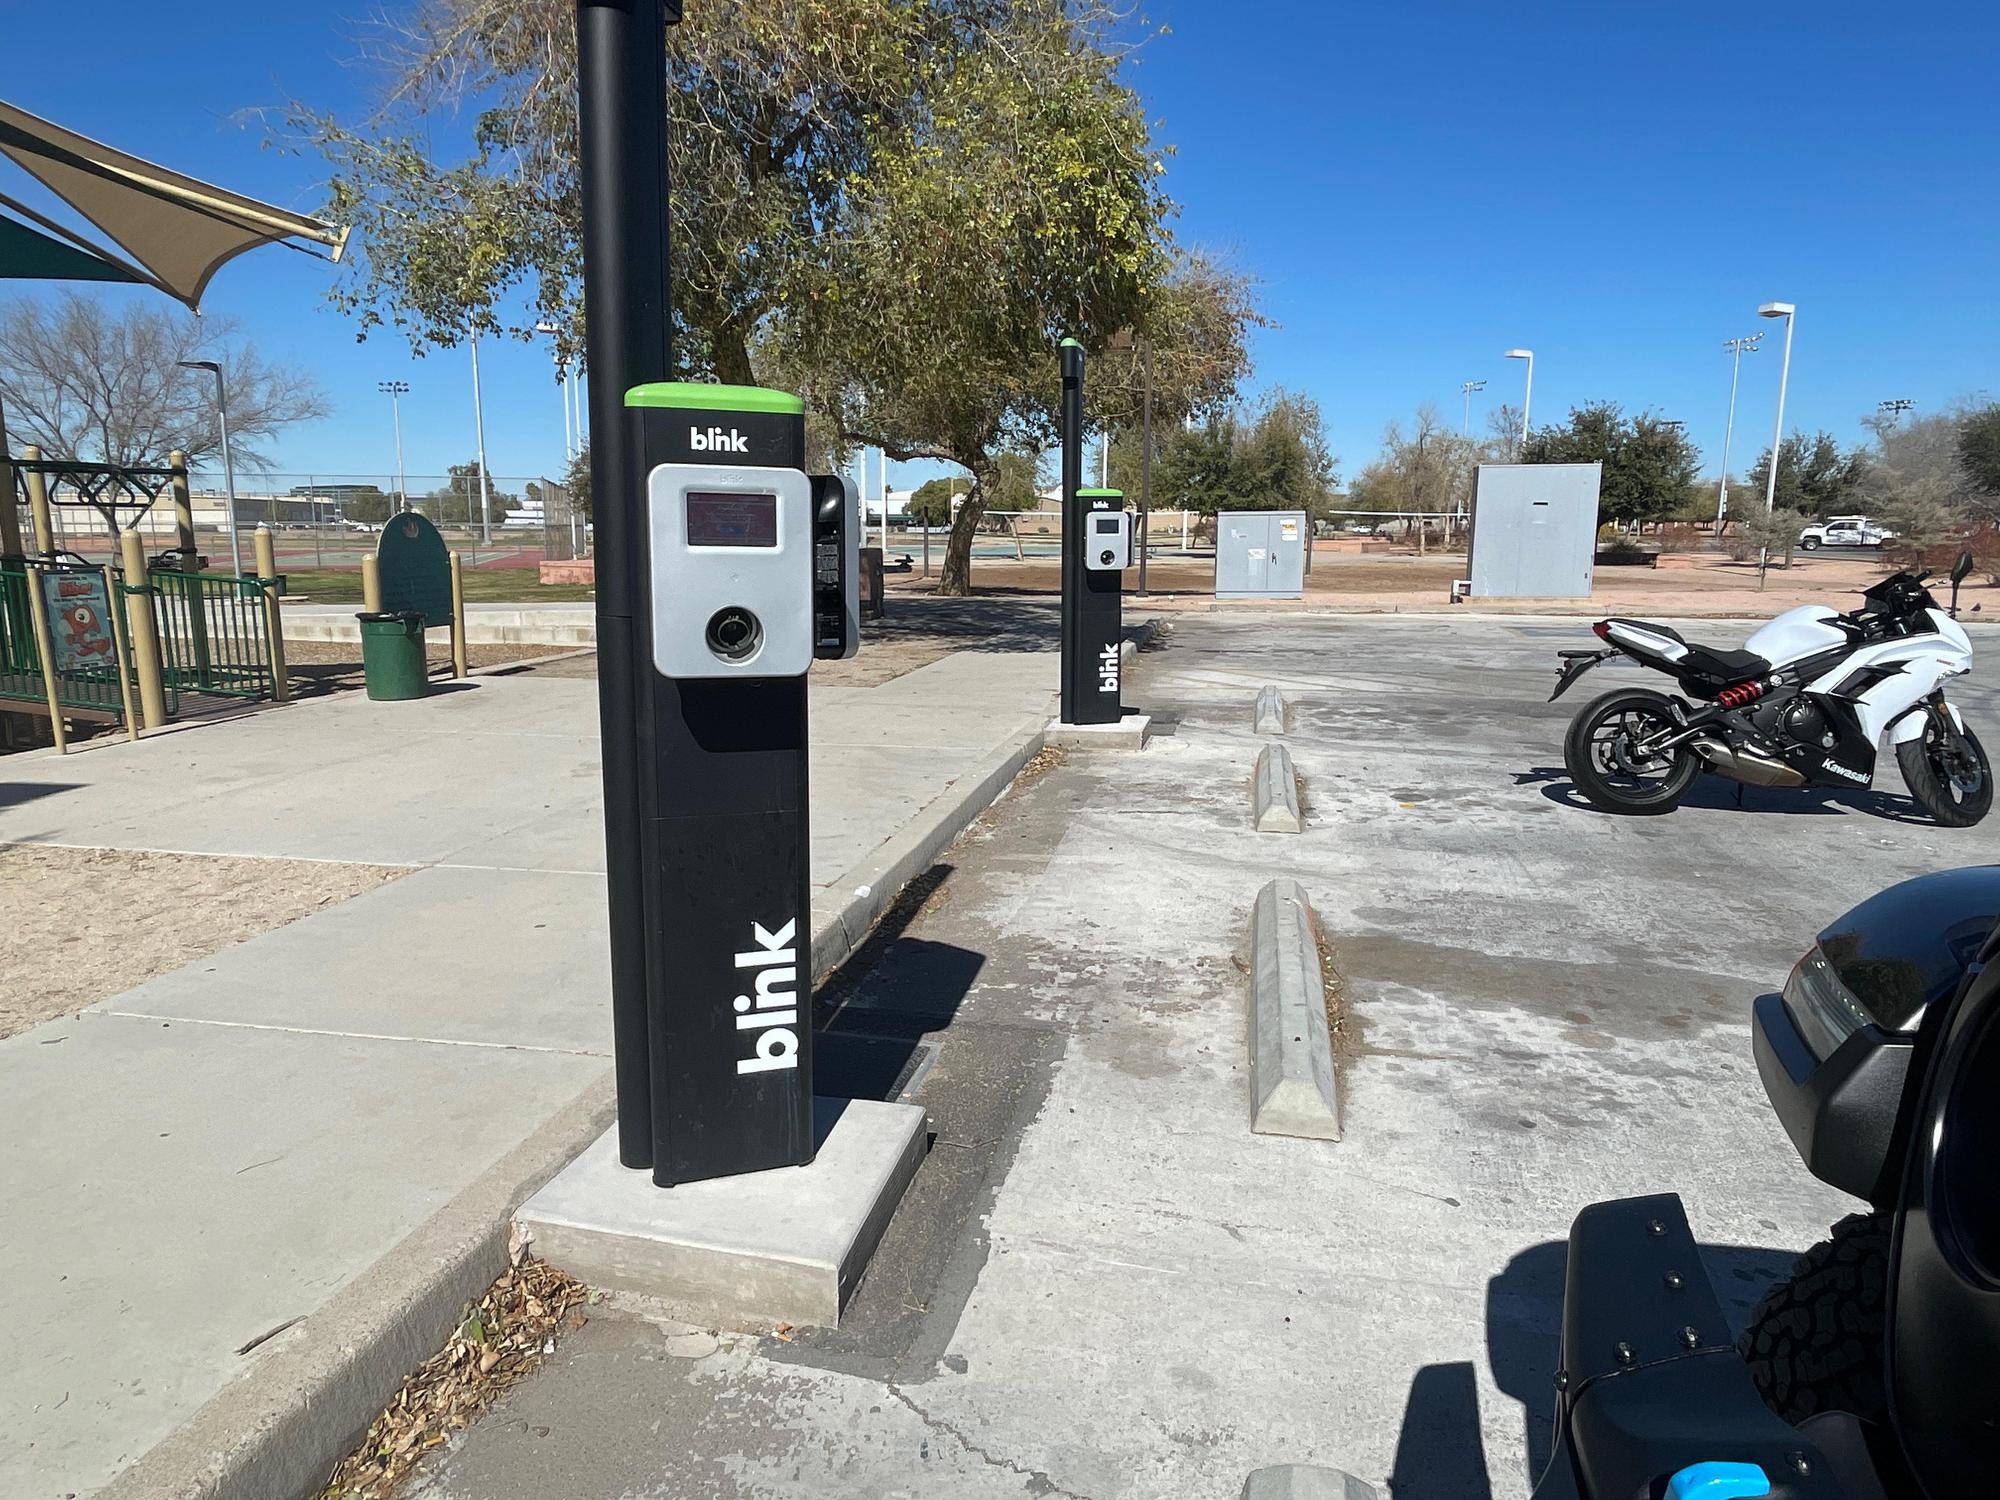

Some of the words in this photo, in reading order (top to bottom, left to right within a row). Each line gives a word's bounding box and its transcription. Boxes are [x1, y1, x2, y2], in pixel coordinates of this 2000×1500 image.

[690, 426, 749, 453] blink
[1098, 642, 1119, 692] blink
[1821, 757, 1871, 784] Kawasaki
[732, 916, 799, 1075] blink
